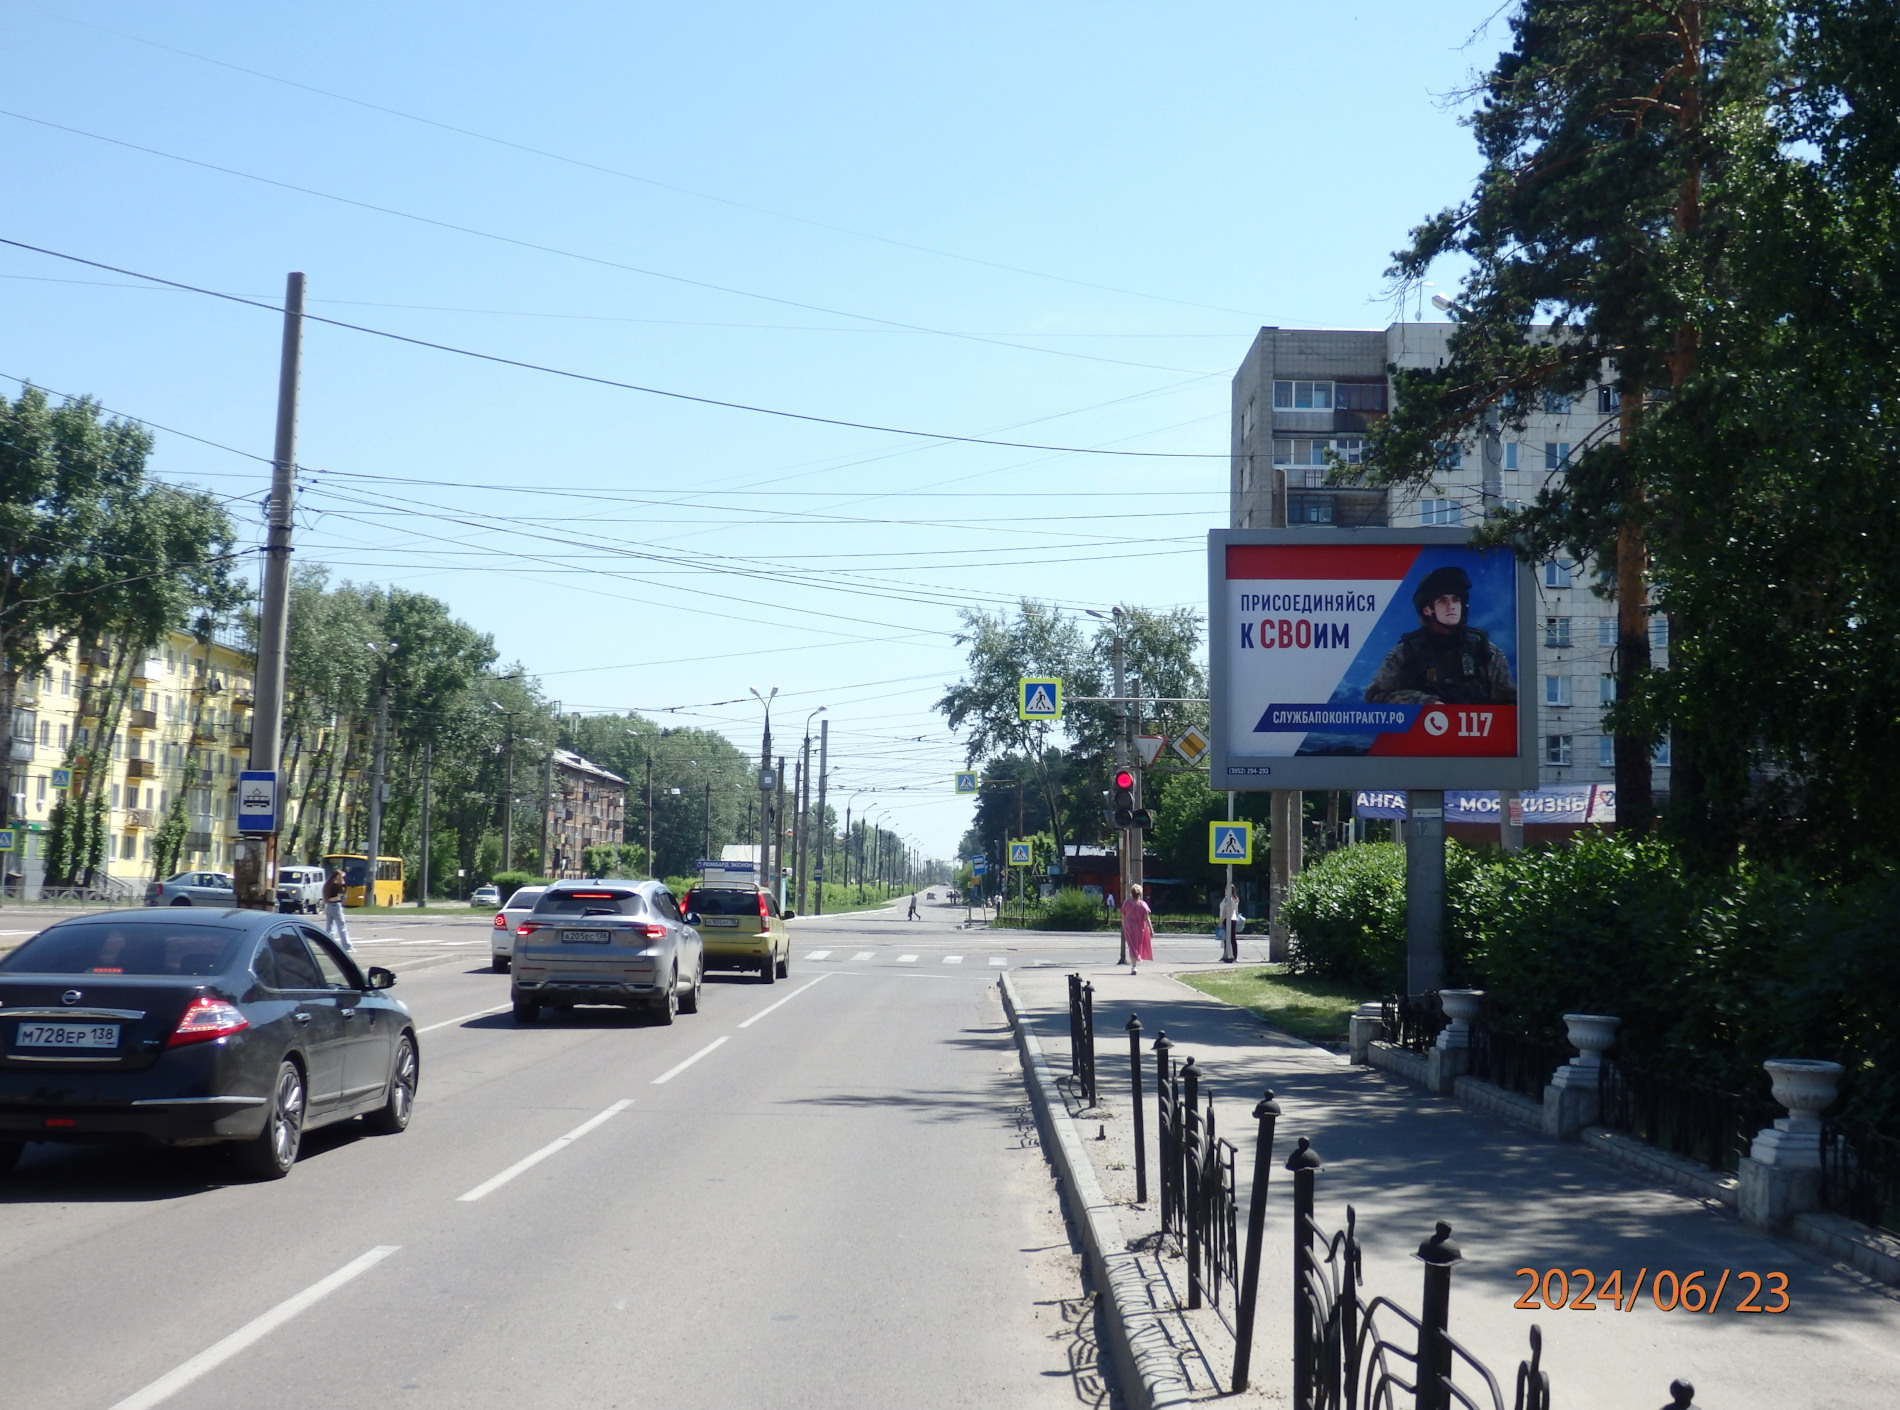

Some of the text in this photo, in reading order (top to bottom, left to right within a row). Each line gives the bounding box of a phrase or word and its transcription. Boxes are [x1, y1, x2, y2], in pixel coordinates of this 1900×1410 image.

[1241, 591, 1375, 613] ПРИСОЕДИНЯЙСЯ
[1241, 623, 1254, 648] К
[1273, 711, 1405, 724] СЛУЖБАПОКОНТРАКТУ.РФ
[1458, 712, 1493, 736] 117
[1357, 792, 1406, 809] АНГА
[1460, 797, 1500, 812] МОЯ
[22, 1028, 113, 1044] М728ЕР 138
